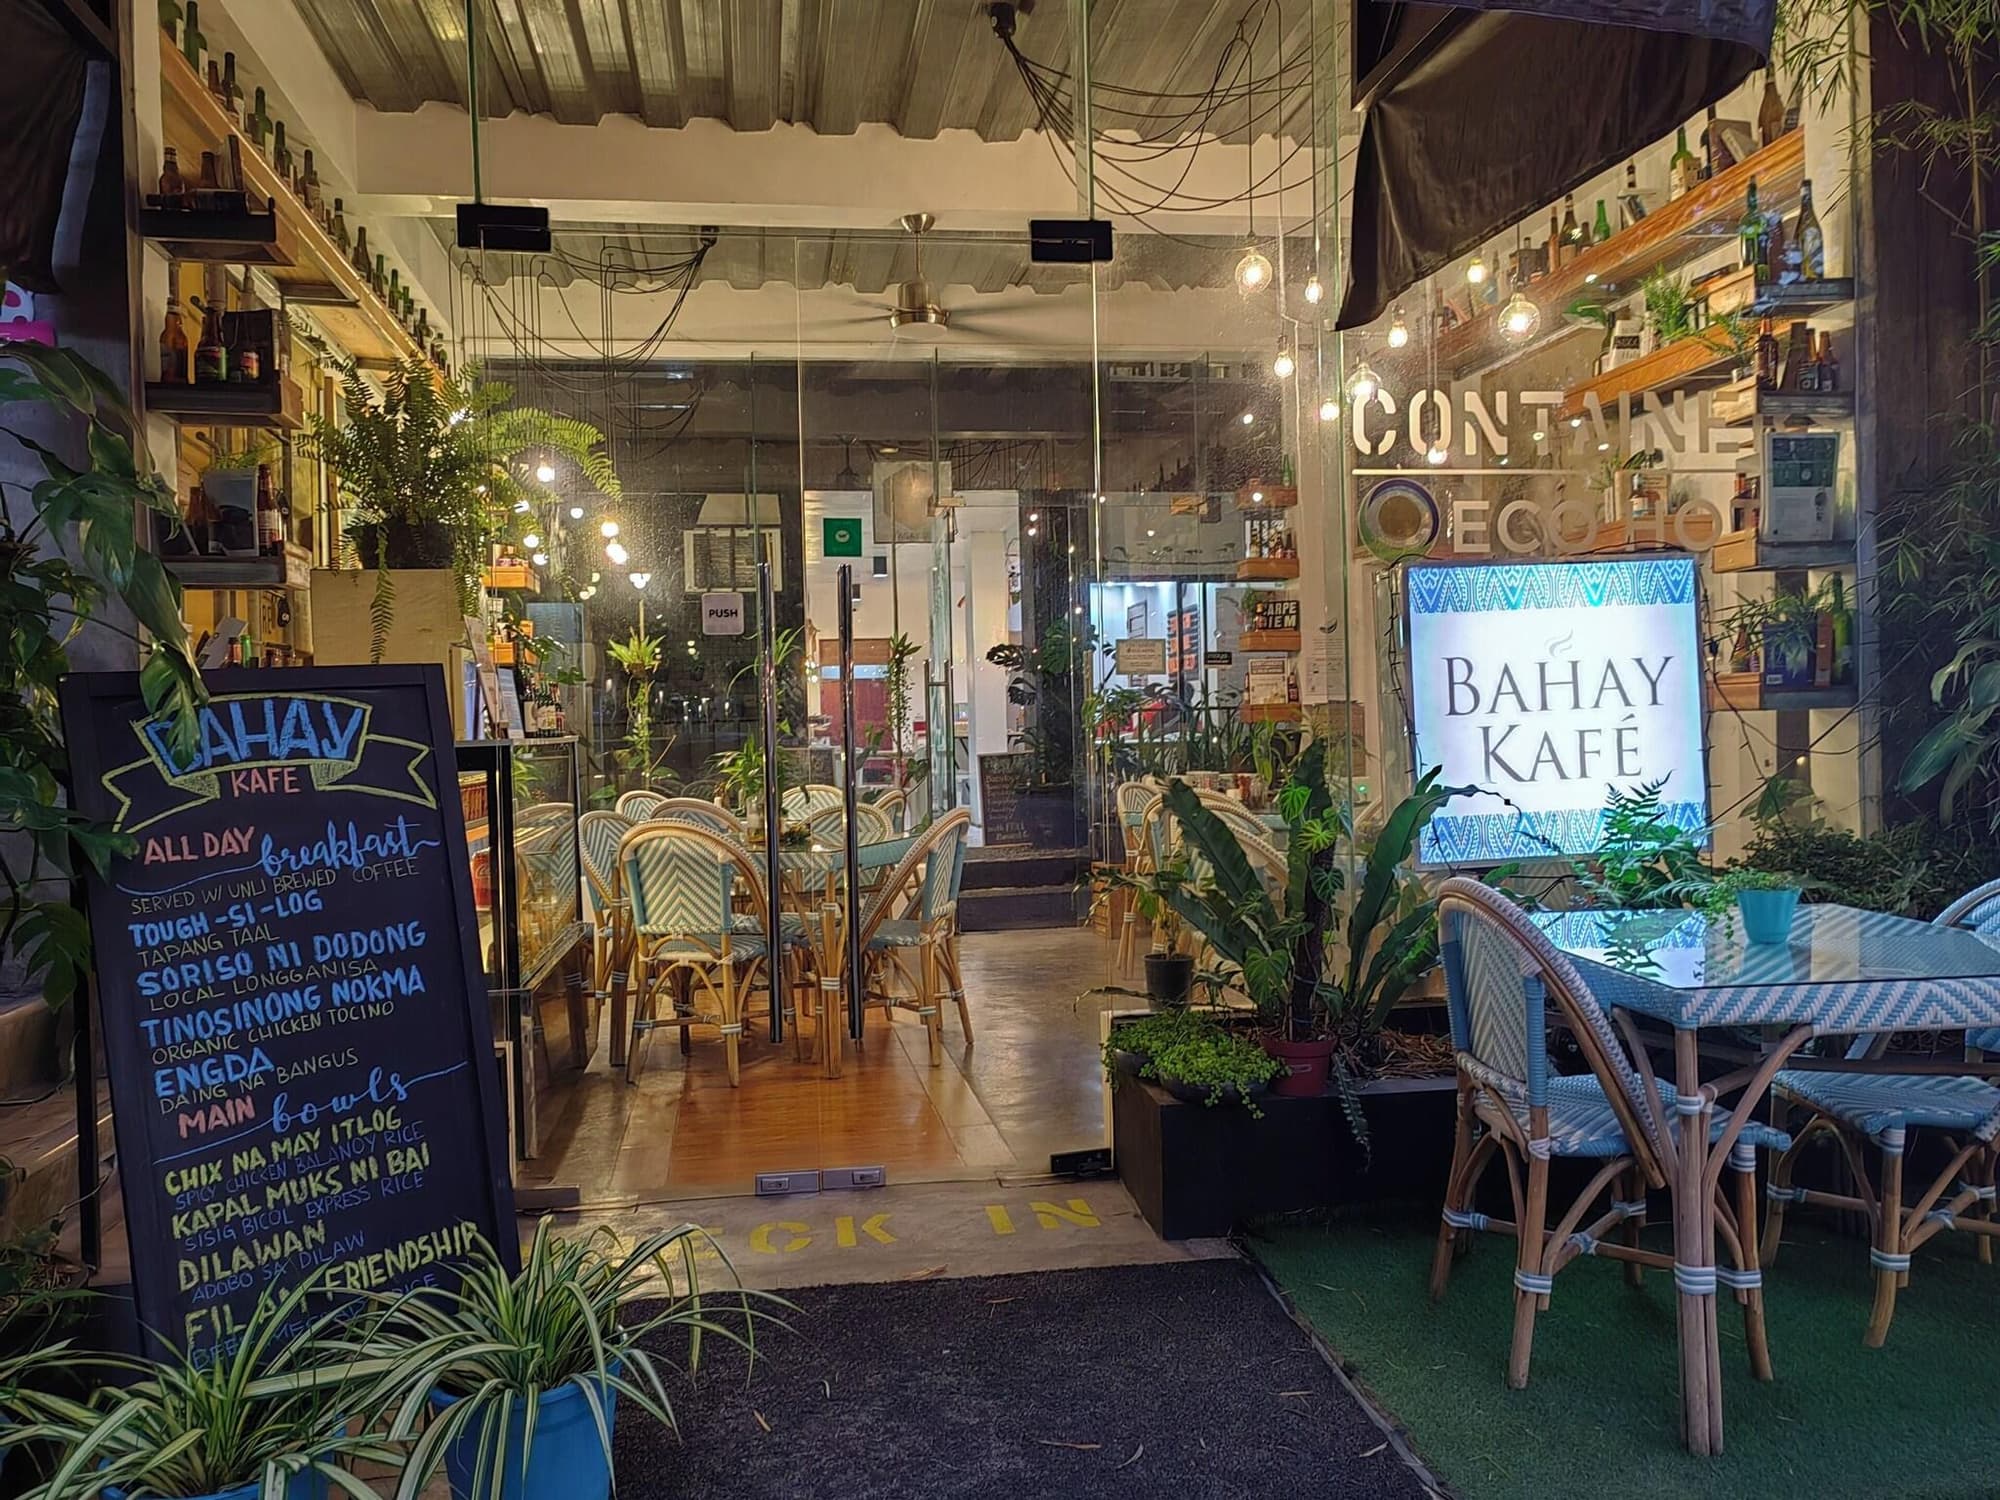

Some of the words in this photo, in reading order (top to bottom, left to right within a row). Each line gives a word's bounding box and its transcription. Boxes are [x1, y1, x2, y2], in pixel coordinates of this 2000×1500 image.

[708, 607, 739, 620] PUSH
[1261, 601, 1297, 616] ARPE
[1441, 655, 1675, 717] BAHAY
[1476, 713, 1643, 785] KAFÉ
[230, 767, 301, 798] KAFE
[143, 836, 200, 865] ALL
[202, 826, 254, 858] DAY
[260, 815, 440, 877] breakfast
[131, 890, 196, 916] SERVED
[201, 884, 223, 905] W/
[227, 878, 266, 901] UNLI
[273, 868, 337, 894] BREWED
[352, 857, 420, 883] COFFEE
[136, 950, 254, 997] SORISO
[265, 940, 304, 972] NI
[313, 920, 427, 962] DODONG
[138, 929, 225, 969] TAPANG
[227, 922, 281, 945] TAAL
[139, 985, 322, 1049] TINOSINONG
[150, 984, 225, 1013] LOCAL
[233, 958, 379, 995] LONGGANISA
[152, 1033, 240, 1066] ORGANIC
[248, 1011, 322, 1045] CHICKEN
[329, 1000, 396, 1026] TOCINO
[153, 1046, 275, 1098] ENGDA
[159, 1084, 228, 1115] DAING
[239, 1073, 266, 1094] NA
[277, 1047, 360, 1086] BANGUS
[178, 1095, 256, 1139] MAIN
[271, 1064, 410, 1134] bowls
[164, 1158, 224, 1197] CHIX
[231, 1145, 267, 1176] NA
[271, 1127, 321, 1164] MAY
[331, 1104, 402, 1146] ITLOG
[174, 1181, 217, 1212] SPICY
[225, 1160, 289, 1195] CHICKEN
[384, 1119, 425, 1146] RICE
[171, 1194, 262, 1240] KAPAL
[266, 1164, 344, 1209] MUKS
[350, 1153, 380, 1186] NI
[386, 1142, 431, 1177] BAI
[184, 1224, 237, 1252] SISIG
[242, 1211, 295, 1236] BICOL
[305, 1184, 372, 1220] EXPRESS
[380, 1169, 426, 1198] RICE
[984, 1198, 1102, 1236] IN
[177, 1219, 327, 1293] DILAWAN
[191, 1272, 255, 1304] ADOBO
[298, 1231, 365, 1270] DILAW
[324, 1220, 479, 1300] FRIENDSHIP
